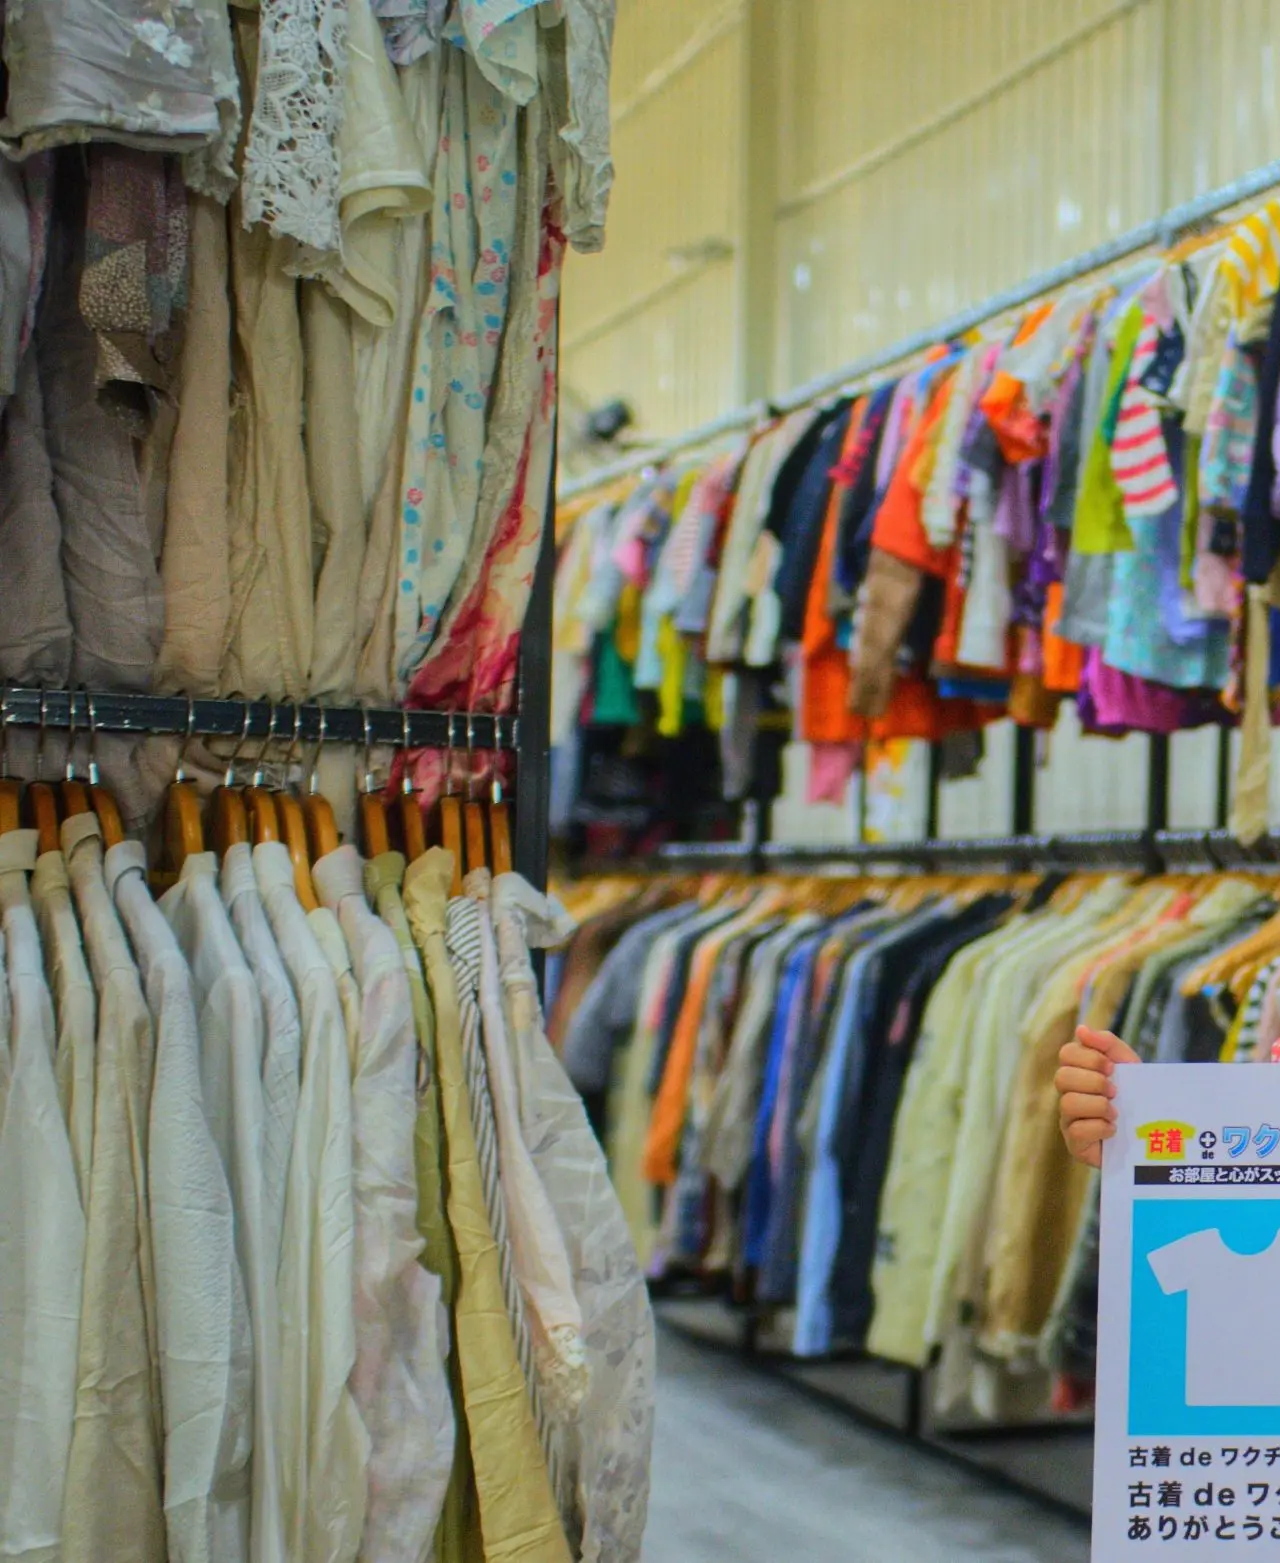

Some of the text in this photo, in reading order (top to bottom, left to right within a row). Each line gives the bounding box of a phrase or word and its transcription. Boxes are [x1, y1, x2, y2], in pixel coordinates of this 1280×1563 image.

[1148, 1128, 1183, 1154] 古着
[1128, 1446, 1171, 1467] 古着
[1179, 1447, 1212, 1466] de
[1128, 1481, 1183, 1508] 古着
[1193, 1482, 1236, 1506] de
